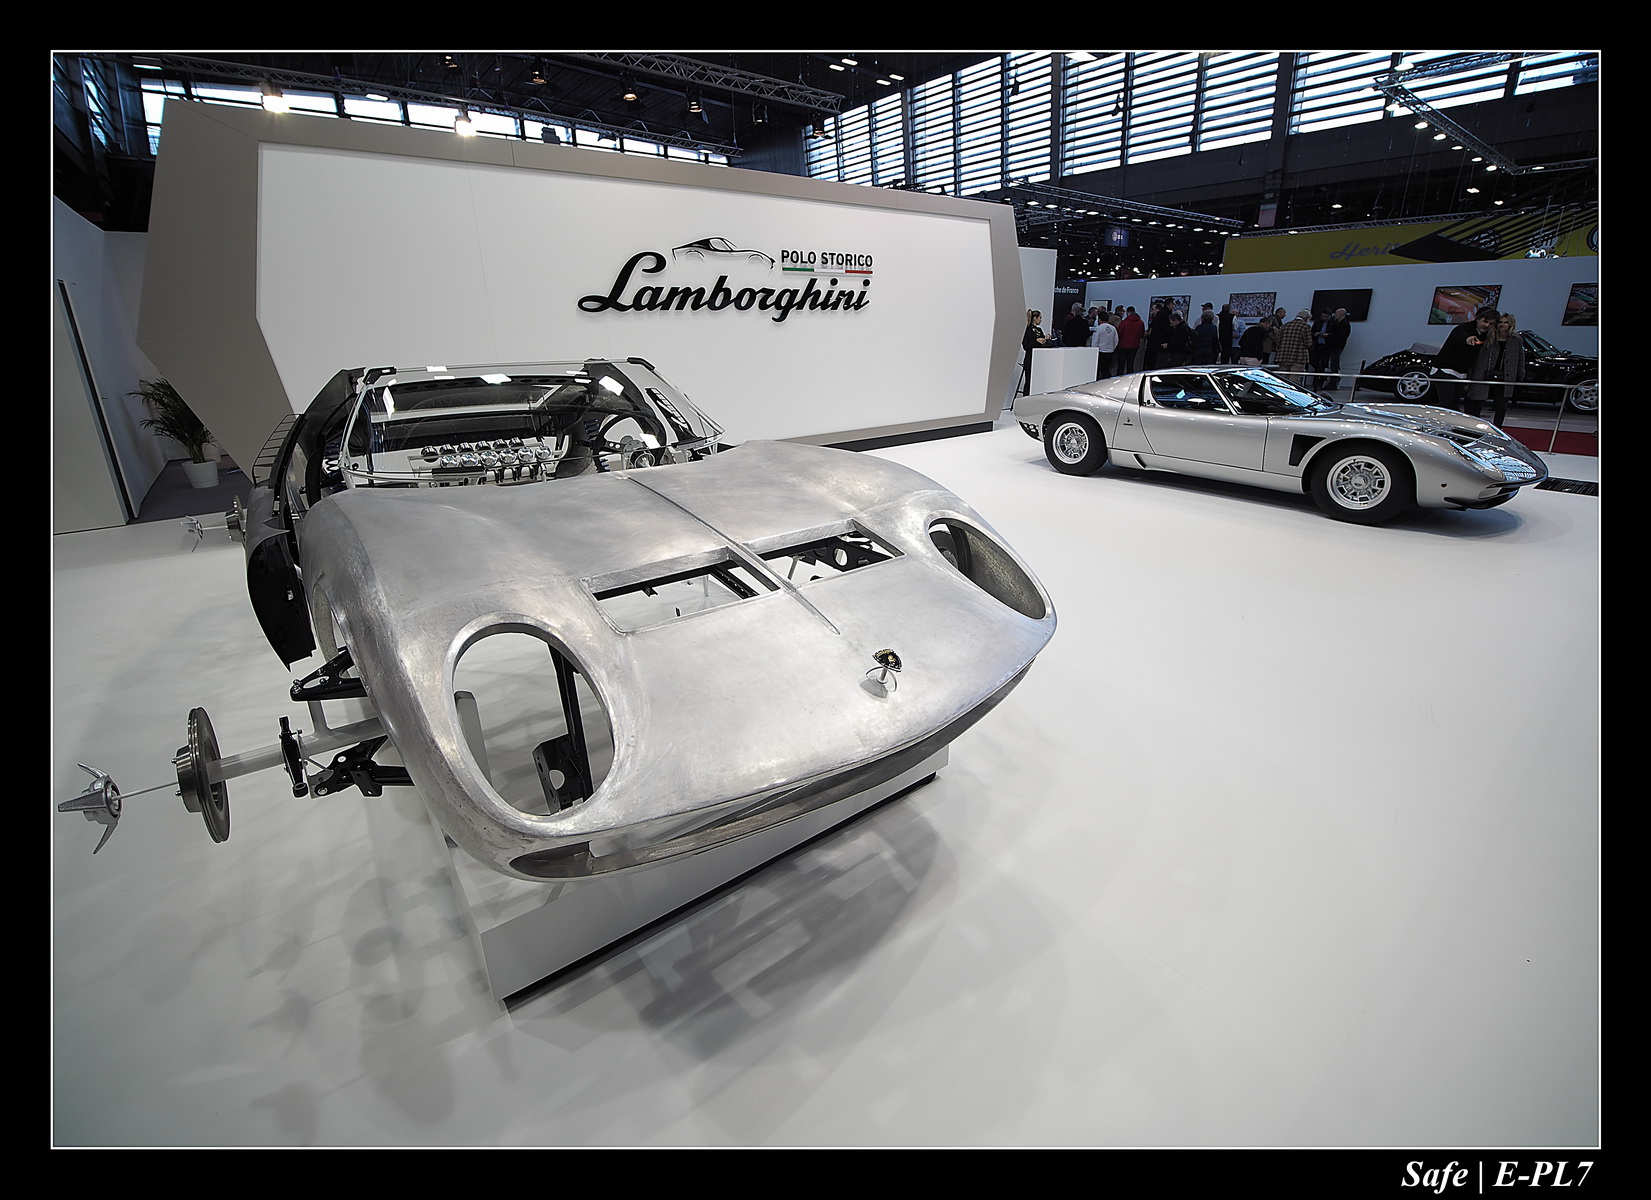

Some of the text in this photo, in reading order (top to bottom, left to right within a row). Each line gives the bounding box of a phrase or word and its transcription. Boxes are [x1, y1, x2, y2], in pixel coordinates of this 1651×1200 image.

[781, 249, 874, 268] POLO STORICO
[1329, 242, 1399, 260] Heri
[577, 251, 872, 323] Lamborghini
